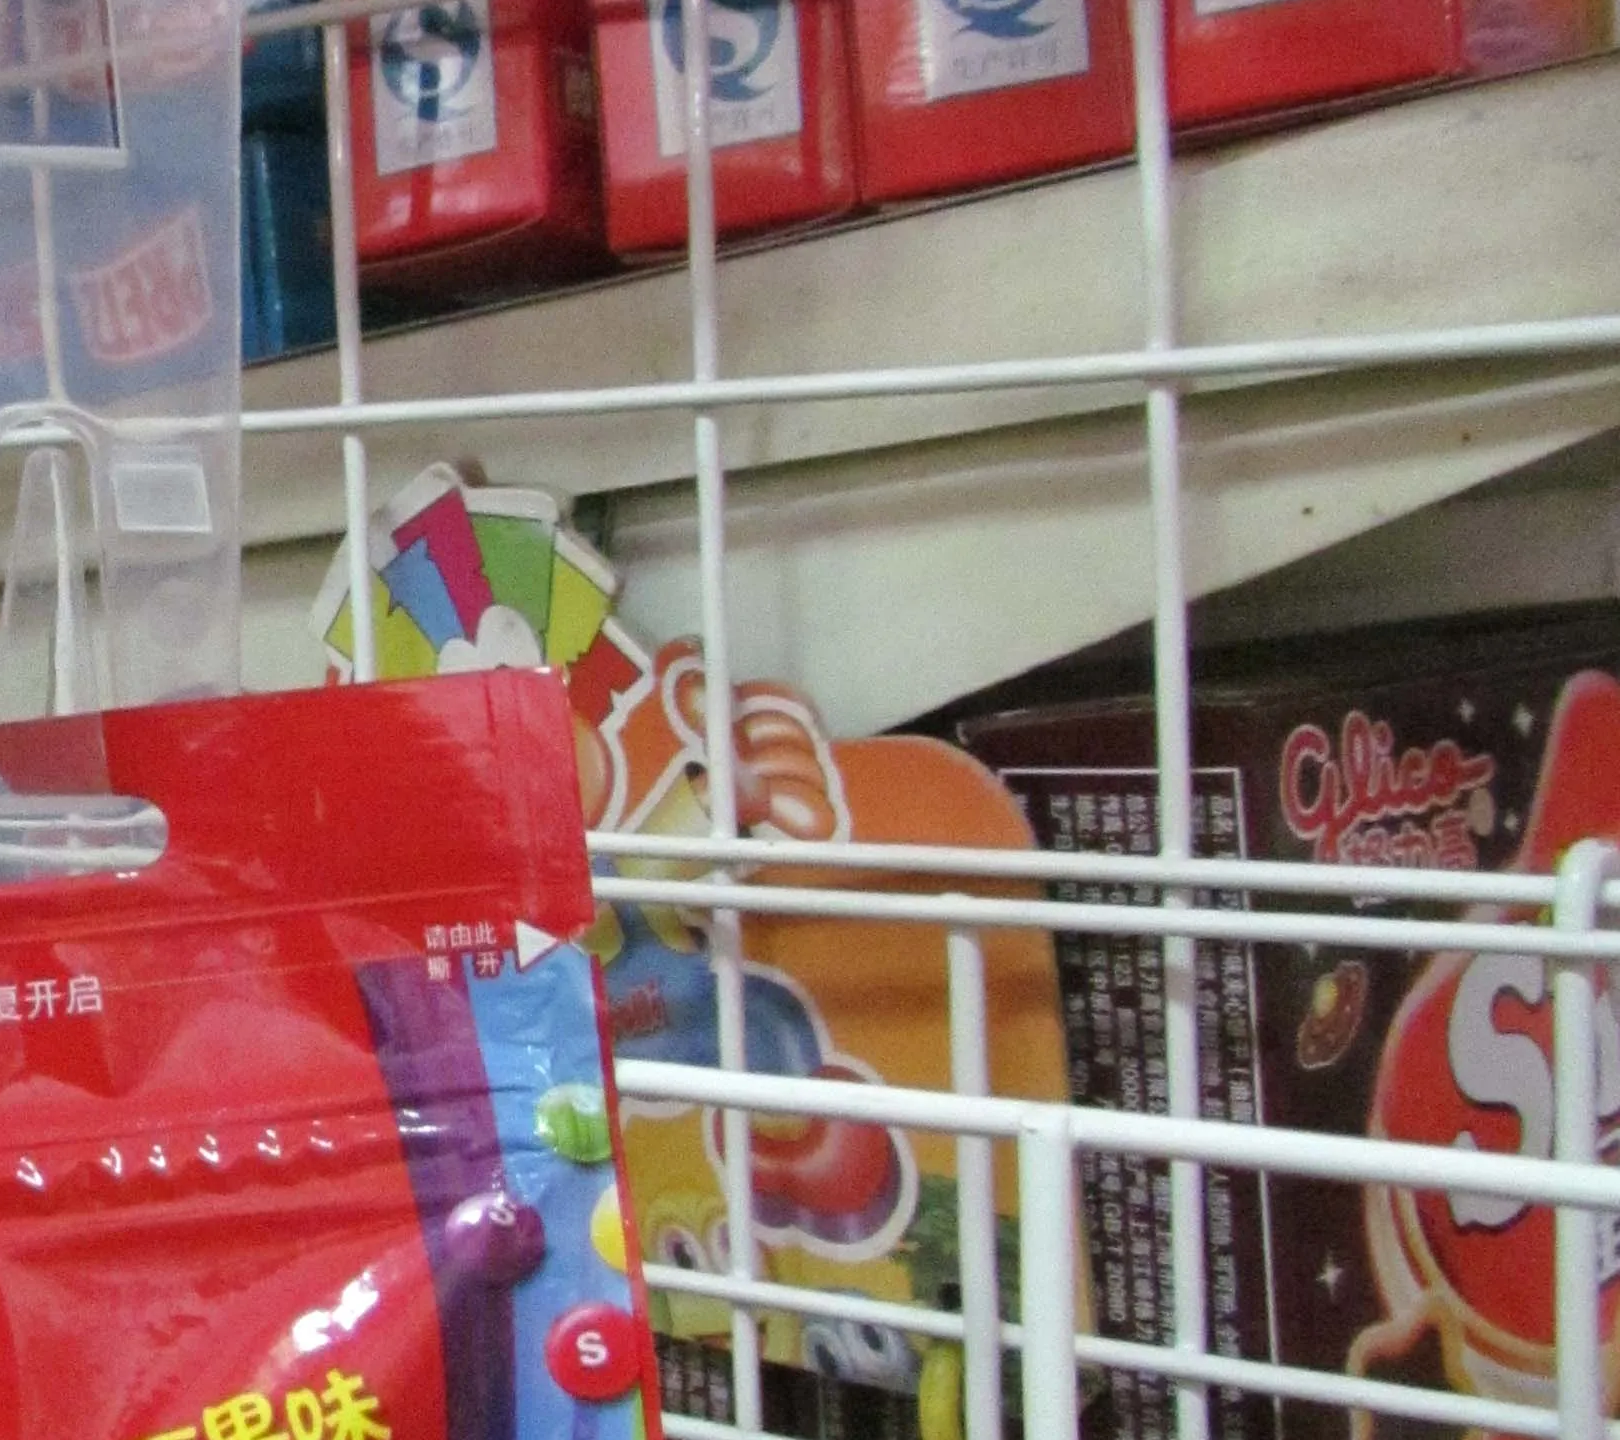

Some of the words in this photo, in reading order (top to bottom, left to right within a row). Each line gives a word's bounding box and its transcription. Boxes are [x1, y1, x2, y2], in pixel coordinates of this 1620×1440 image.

[424, 921, 497, 950] 请由此
[576, 1330, 608, 1366] S
